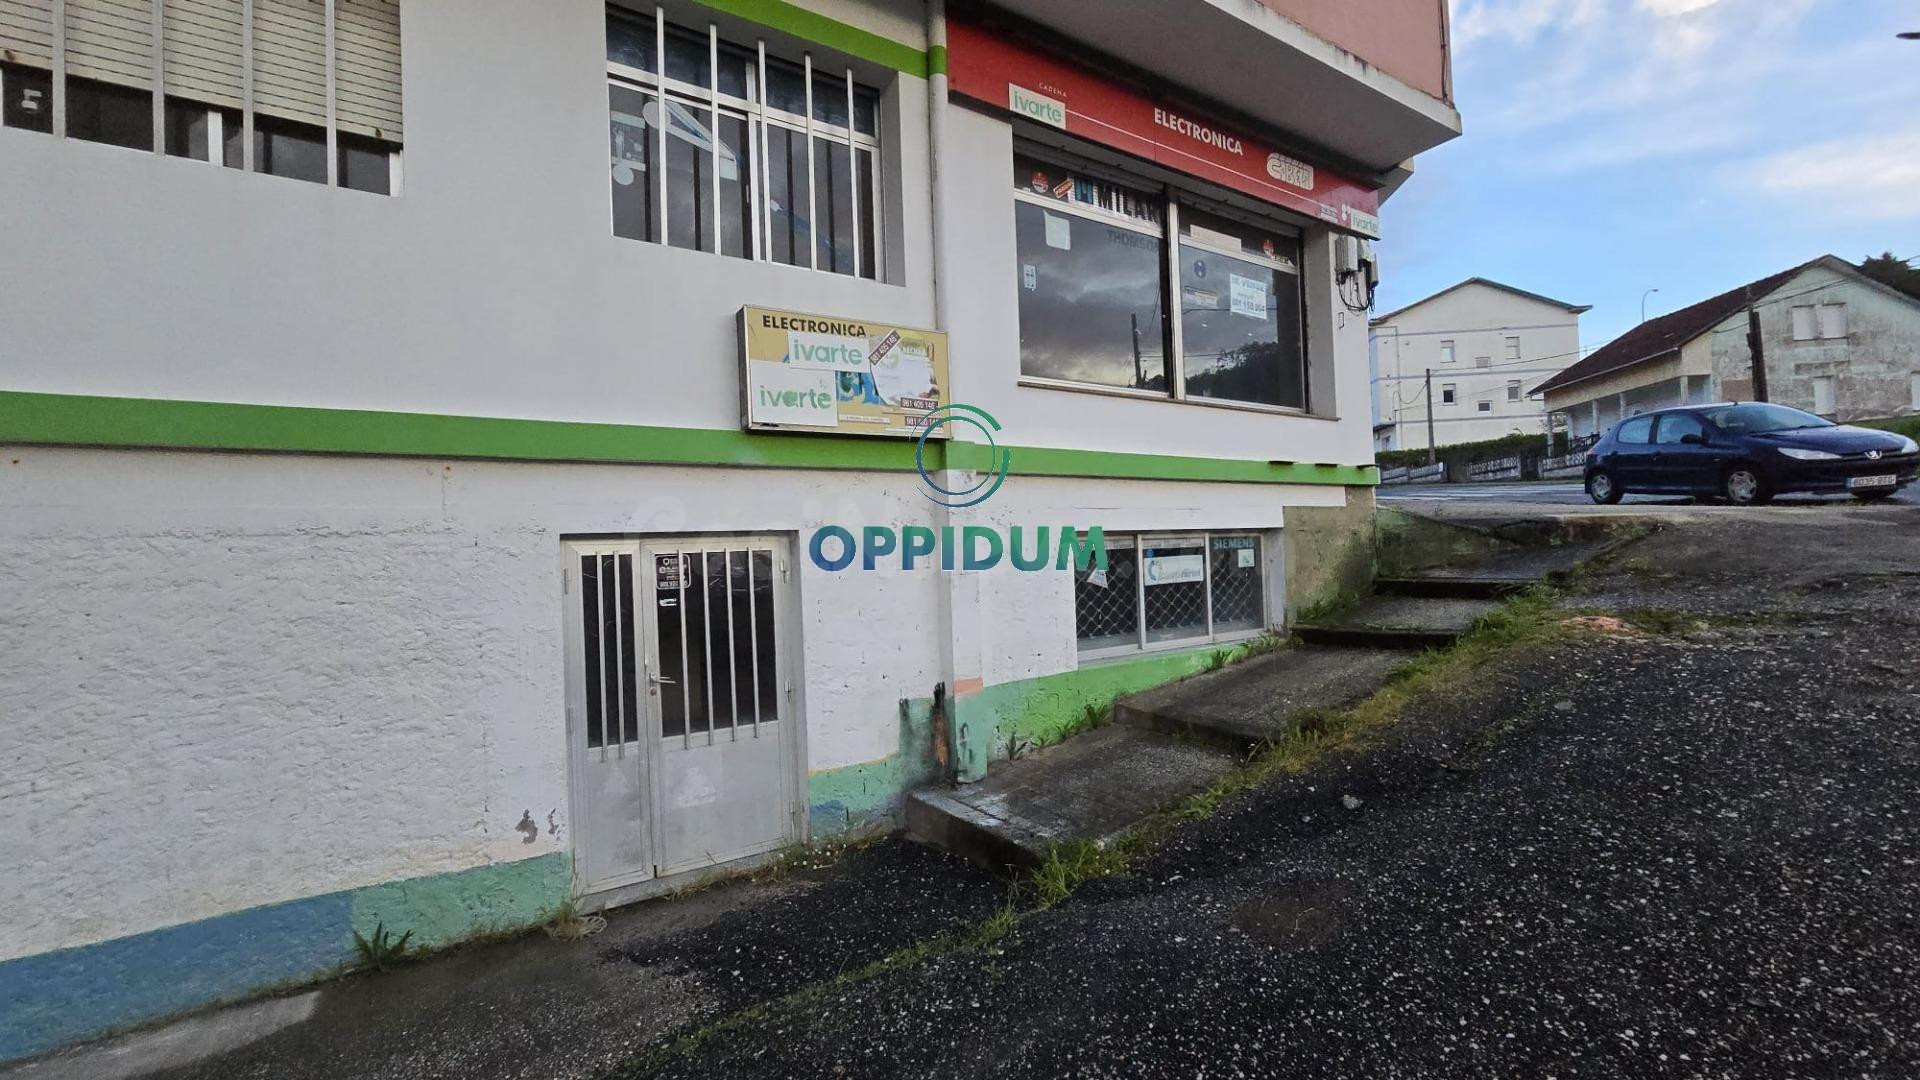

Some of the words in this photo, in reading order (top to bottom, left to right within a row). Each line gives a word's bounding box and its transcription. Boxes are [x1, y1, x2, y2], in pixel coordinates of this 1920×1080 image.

[1038, 82, 1068, 98] CADENA
[1013, 90, 1062, 123] ivarte
[1153, 107, 1243, 156] ELECTRONICA
[762, 315, 866, 338] ELECTRONICA
[793, 339, 863, 365] ivarte
[759, 386, 832, 409] ivarte
[1213, 539, 1255, 550] SIEMENS
